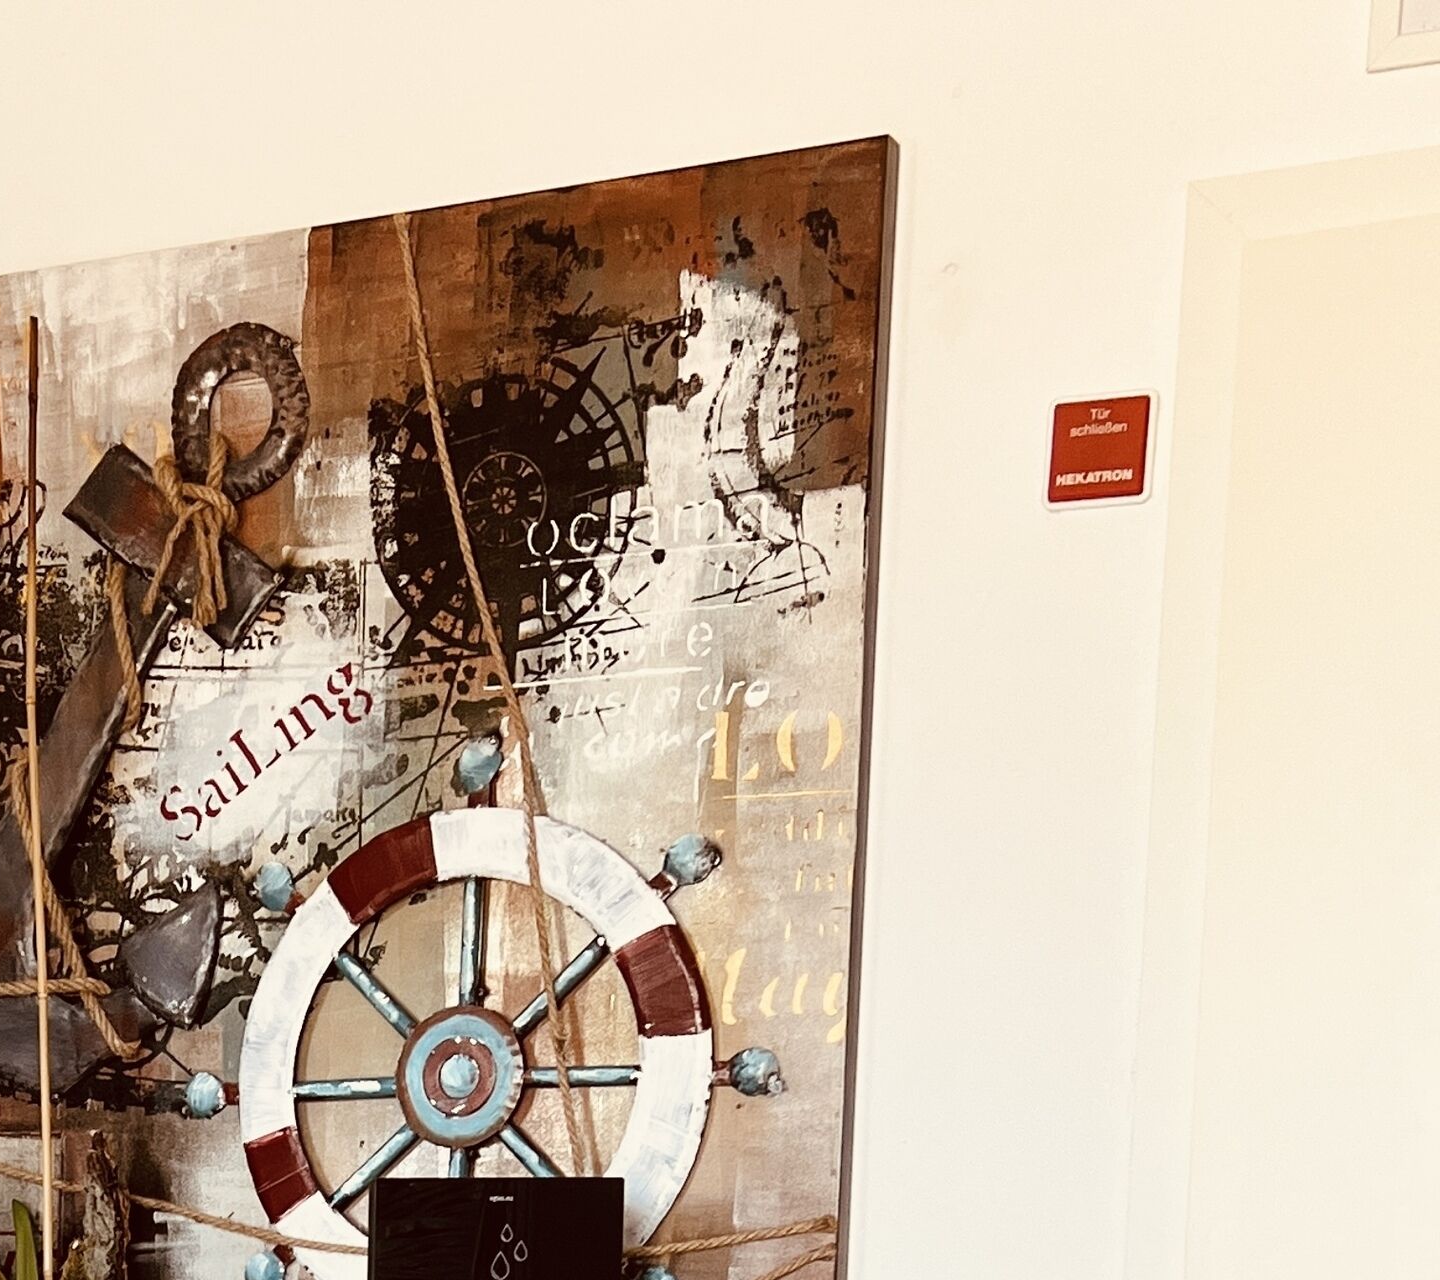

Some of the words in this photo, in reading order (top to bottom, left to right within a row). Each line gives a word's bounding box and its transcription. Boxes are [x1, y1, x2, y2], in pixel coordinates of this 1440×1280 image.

[1089, 408, 1111, 420] Tür
[1069, 422, 1128, 438] schließen
[1055, 468, 1133, 486] HEKATRON
